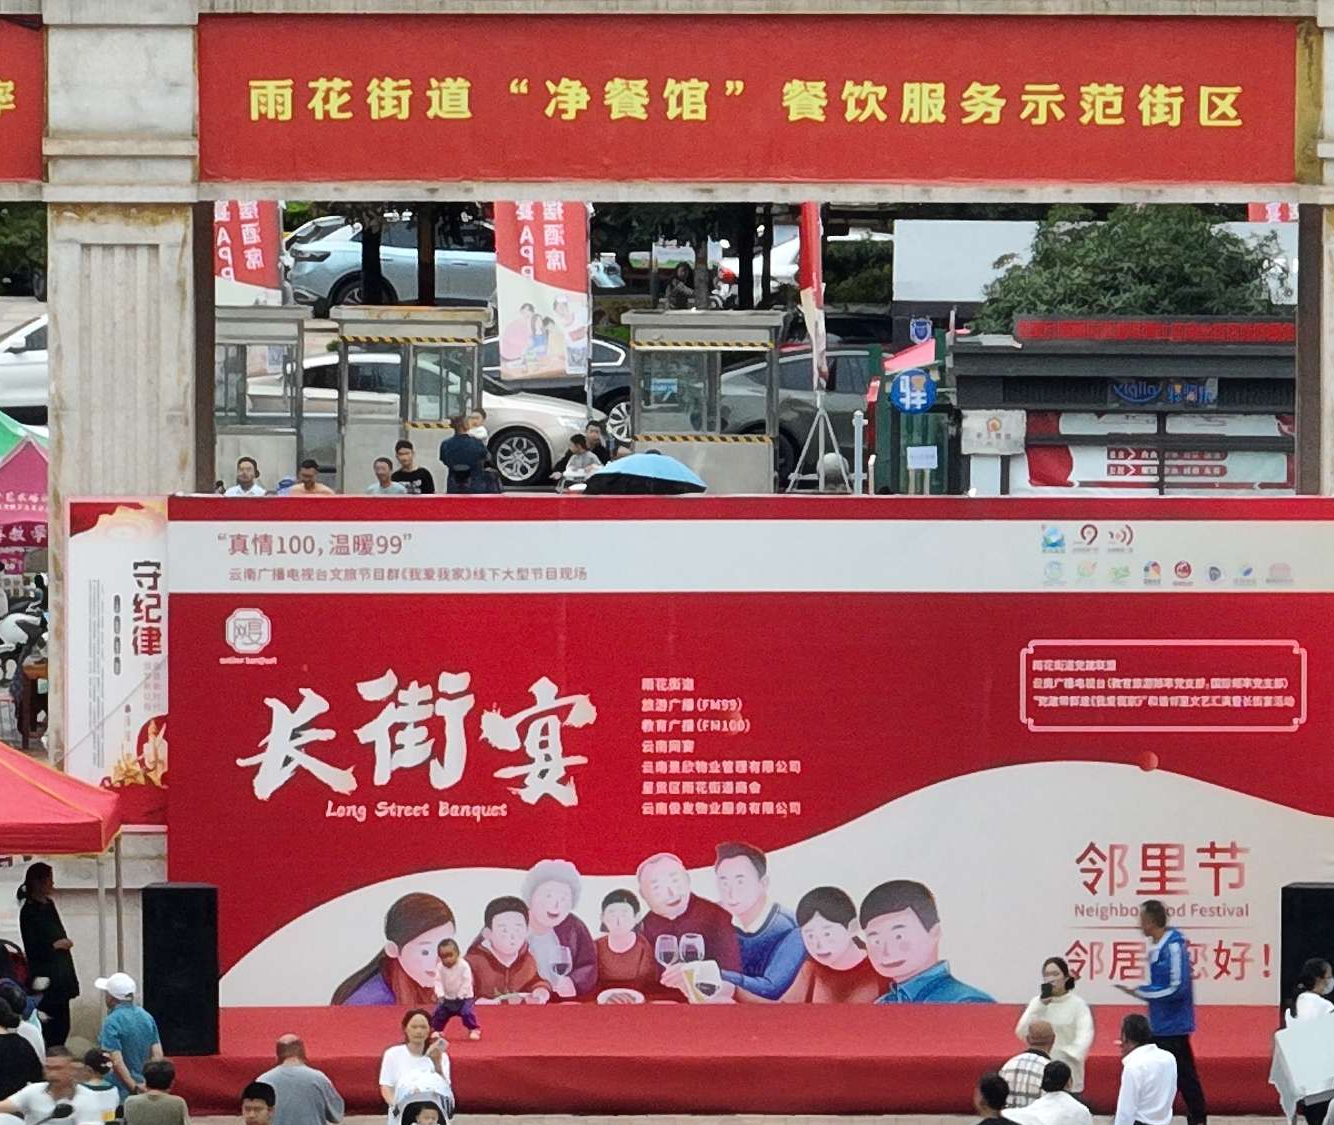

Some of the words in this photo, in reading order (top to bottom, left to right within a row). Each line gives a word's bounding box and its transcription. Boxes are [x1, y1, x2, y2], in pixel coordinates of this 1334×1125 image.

[132, 560, 162, 656] 守纪律
[235, 669, 598, 806] 长街宴
[325, 801, 367, 822] Long
[374, 801, 430, 817] Street
[438, 802, 508, 822] Banquet
[1075, 841, 1251, 896] 邻里节
[1074, 903, 1186, 921] Neighbood
[1190, 903, 1249, 917] Festival
